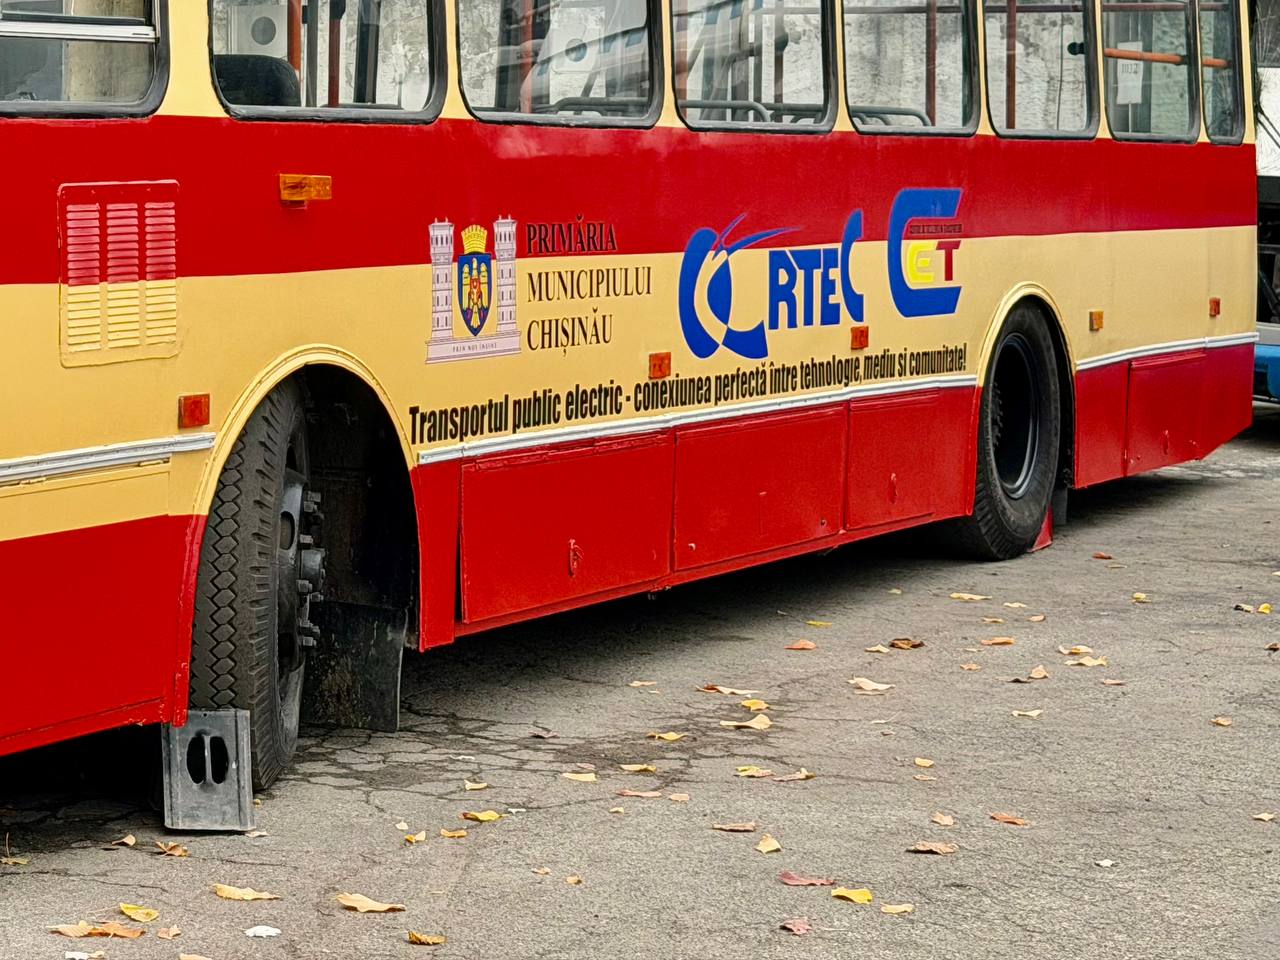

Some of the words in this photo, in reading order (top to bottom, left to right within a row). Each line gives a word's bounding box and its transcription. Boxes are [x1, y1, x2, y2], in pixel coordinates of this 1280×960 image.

[526, 215, 618, 255] PRIMĂRIA
[527, 266, 652, 302] MUNICIPIULUI
[526, 306, 614, 356] CHIȘINĂU
[409, 394, 510, 445] Transportul
[512, 388, 562, 434] public
[565, 379, 623, 421] electric
[634, 373, 712, 412] conexiunea
[714, 361, 767, 406] perfectă
[769, 361, 798, 395] între
[800, 354, 863, 387] tehnologie,
[863, 348, 896, 380] mediu
[897, 347, 908, 377] si
[909, 342, 968, 376] comunitate!
